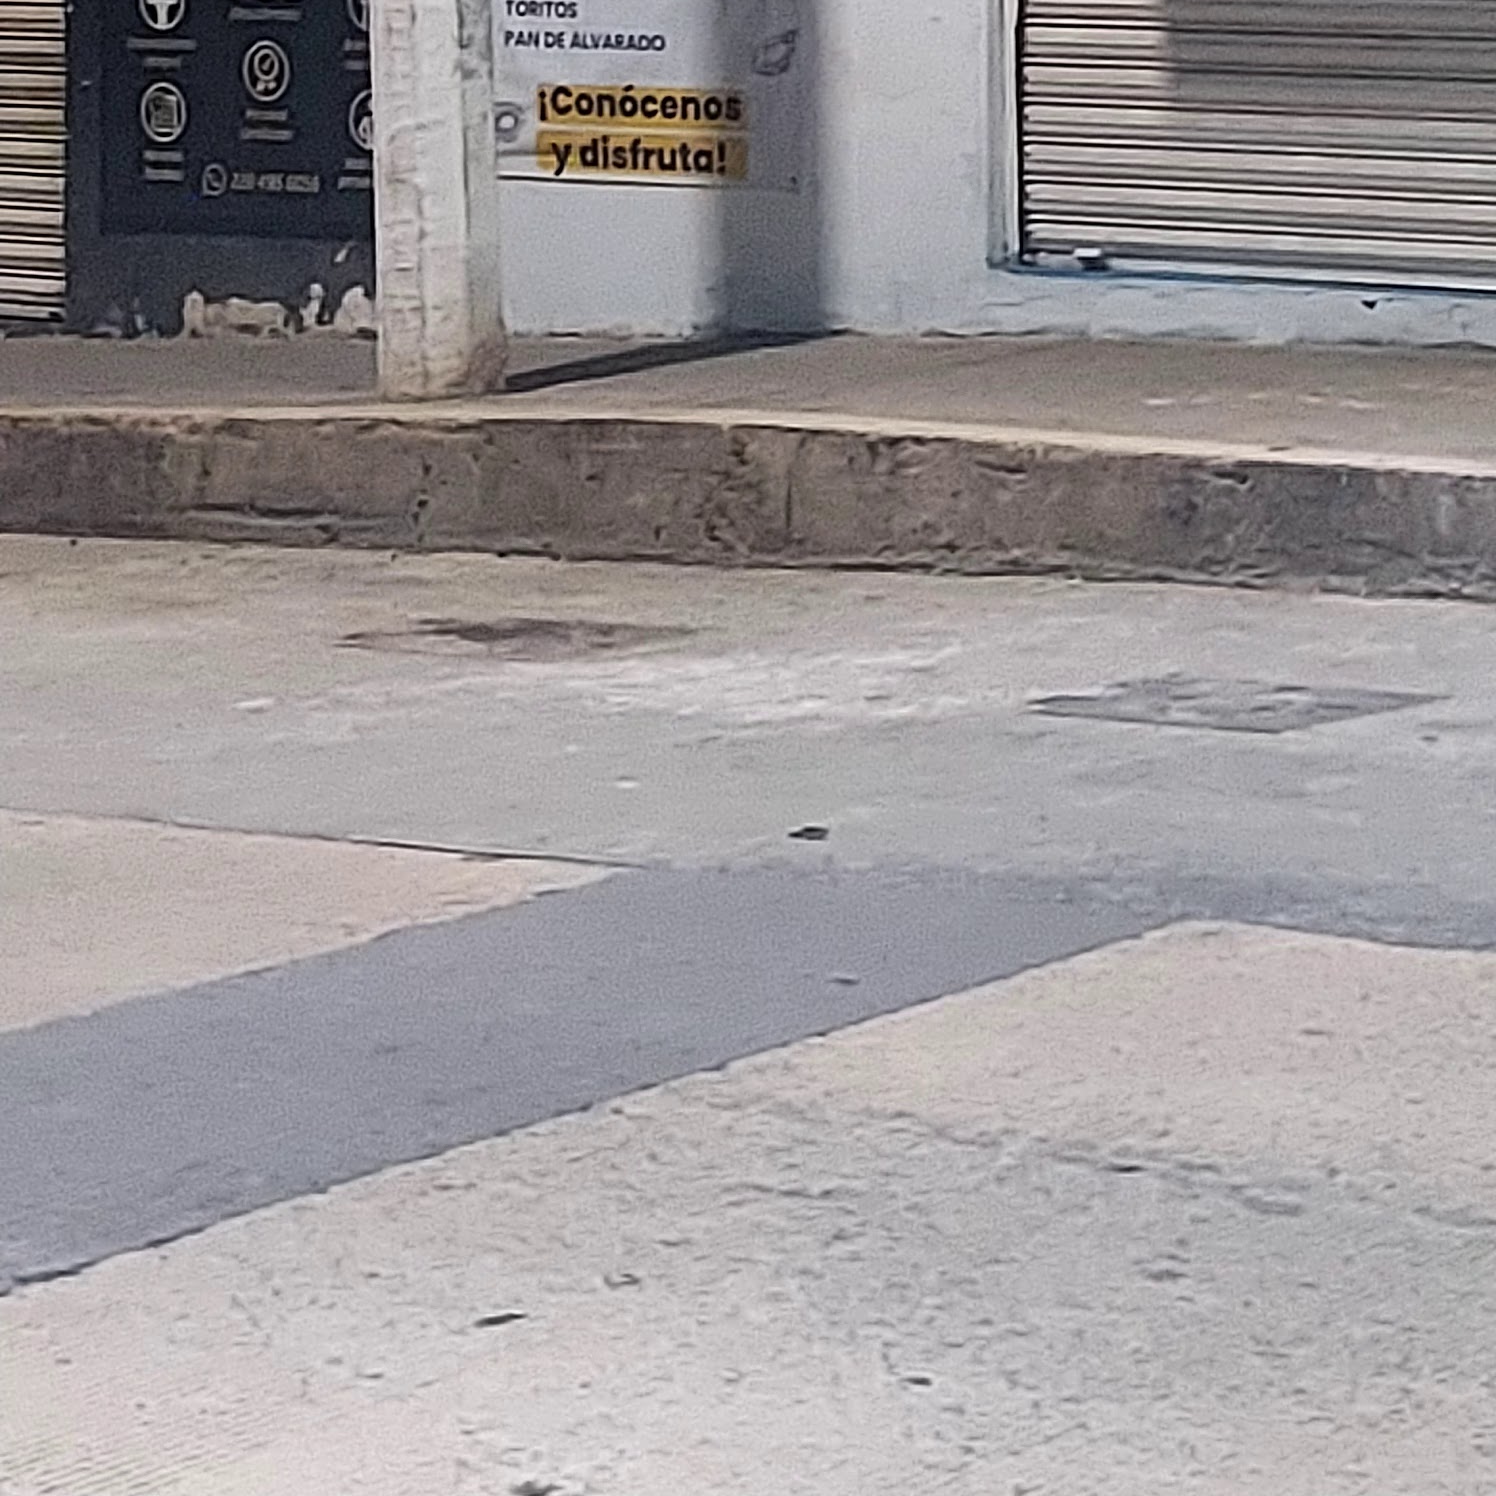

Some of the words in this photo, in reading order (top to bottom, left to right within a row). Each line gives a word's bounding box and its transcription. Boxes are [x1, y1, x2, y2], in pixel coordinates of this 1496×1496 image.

[505, 0, 578, 19] TORITOS
[504, 30, 540, 49] PAN
[543, 31, 566, 50] DE
[569, 31, 667, 52] ALVARADO
[538, 84, 743, 122] ¡Conócenos
[551, 141, 572, 176] y
[579, 135, 727, 174] disfruta!
